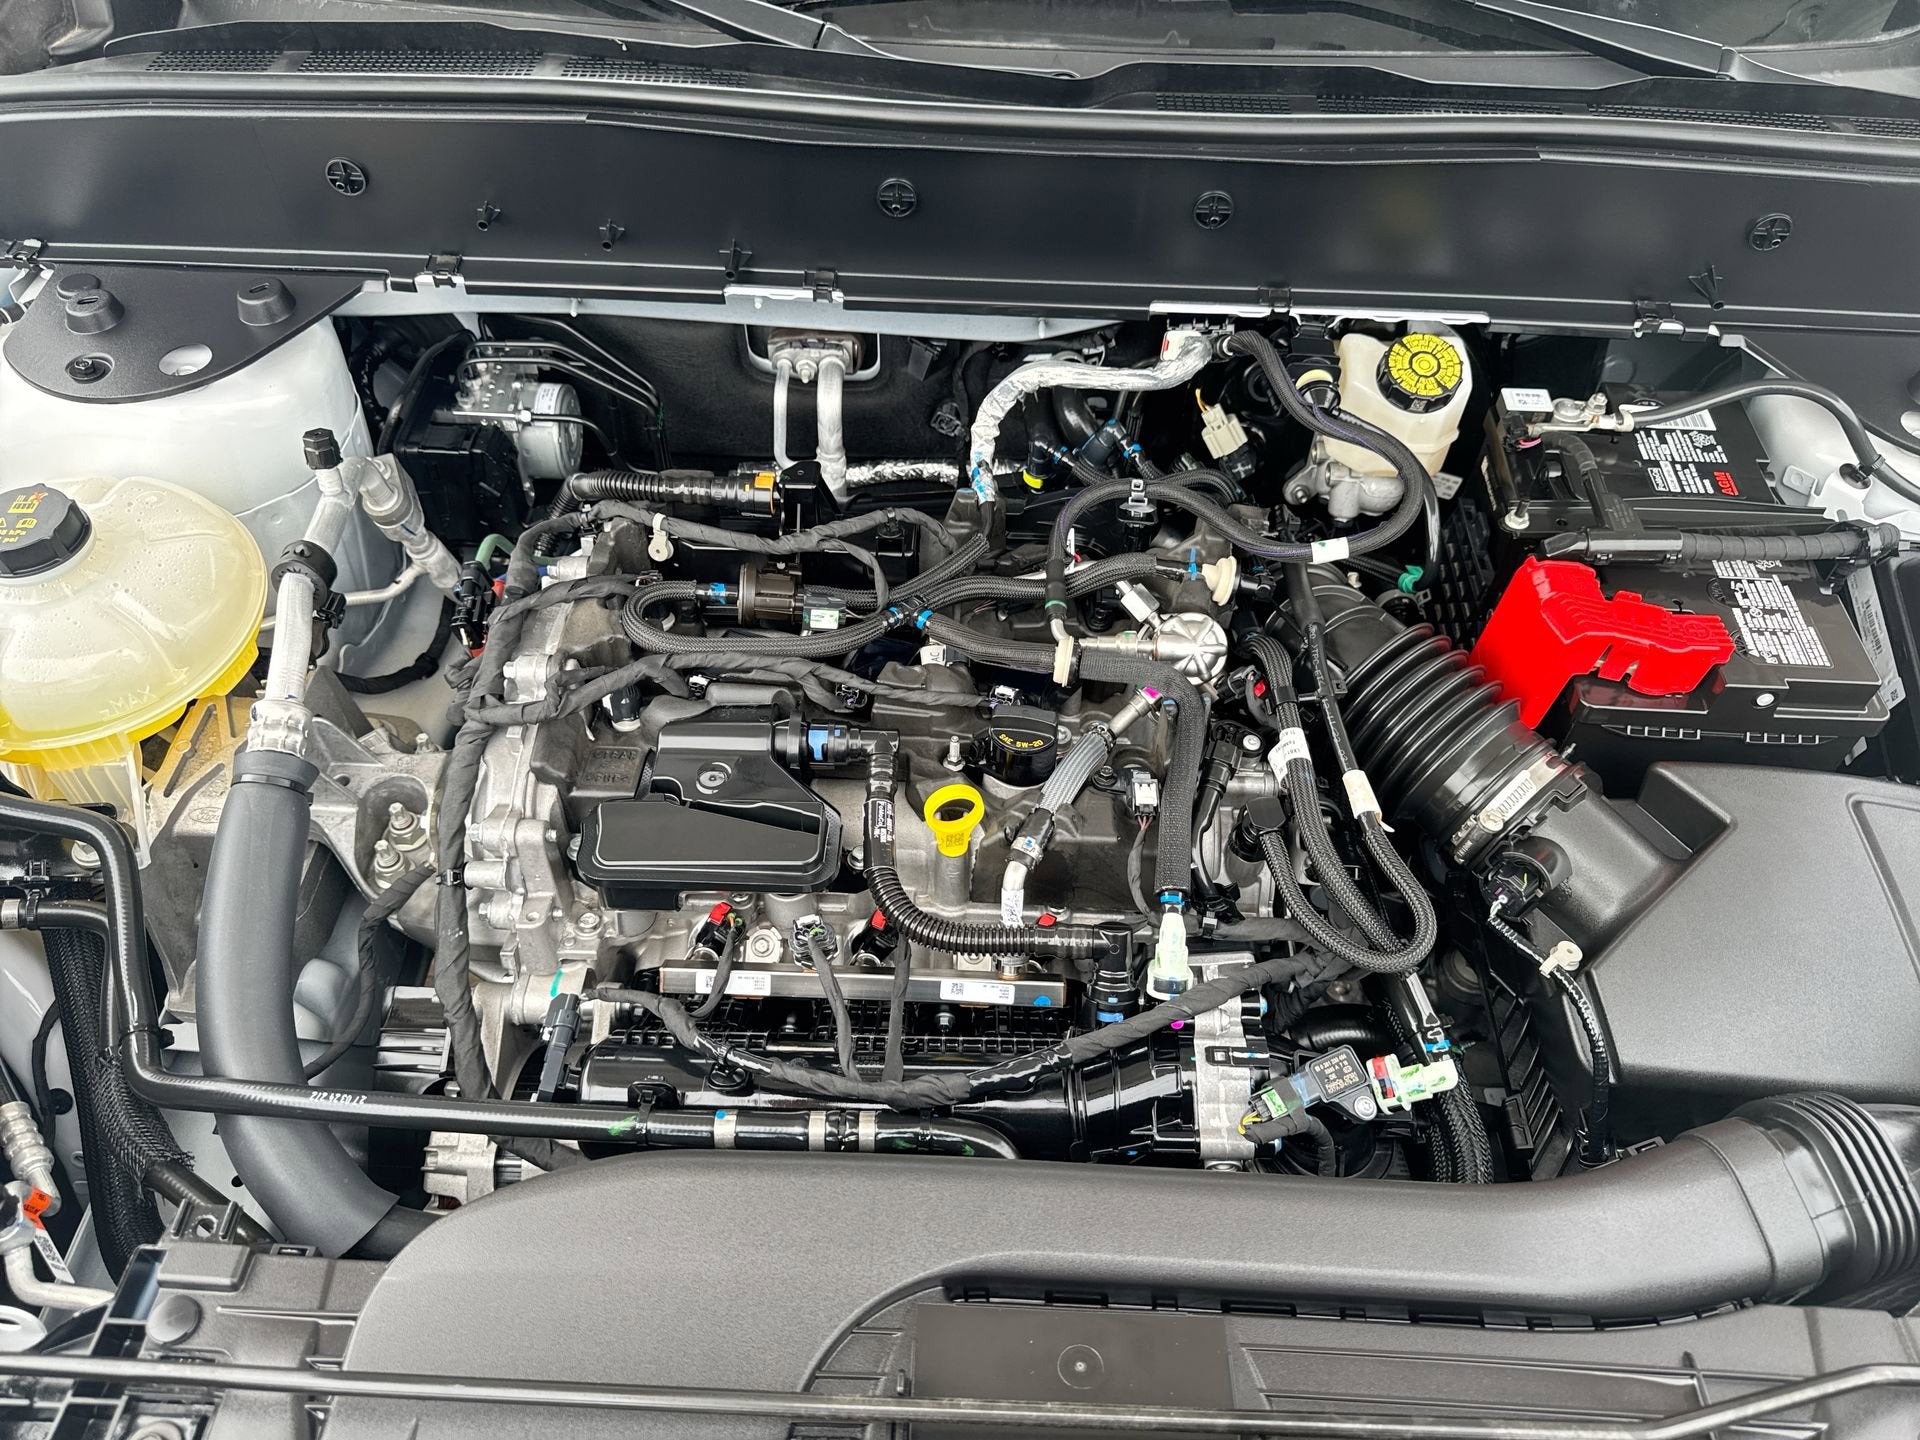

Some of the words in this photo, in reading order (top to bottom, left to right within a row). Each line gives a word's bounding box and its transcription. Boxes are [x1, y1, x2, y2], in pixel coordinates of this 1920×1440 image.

[1713, 471, 1735, 496] AGM
[109, 685, 158, 715] MAX
[999, 733, 1014, 745] SAE
[1016, 739, 1044, 748] 5W-20
